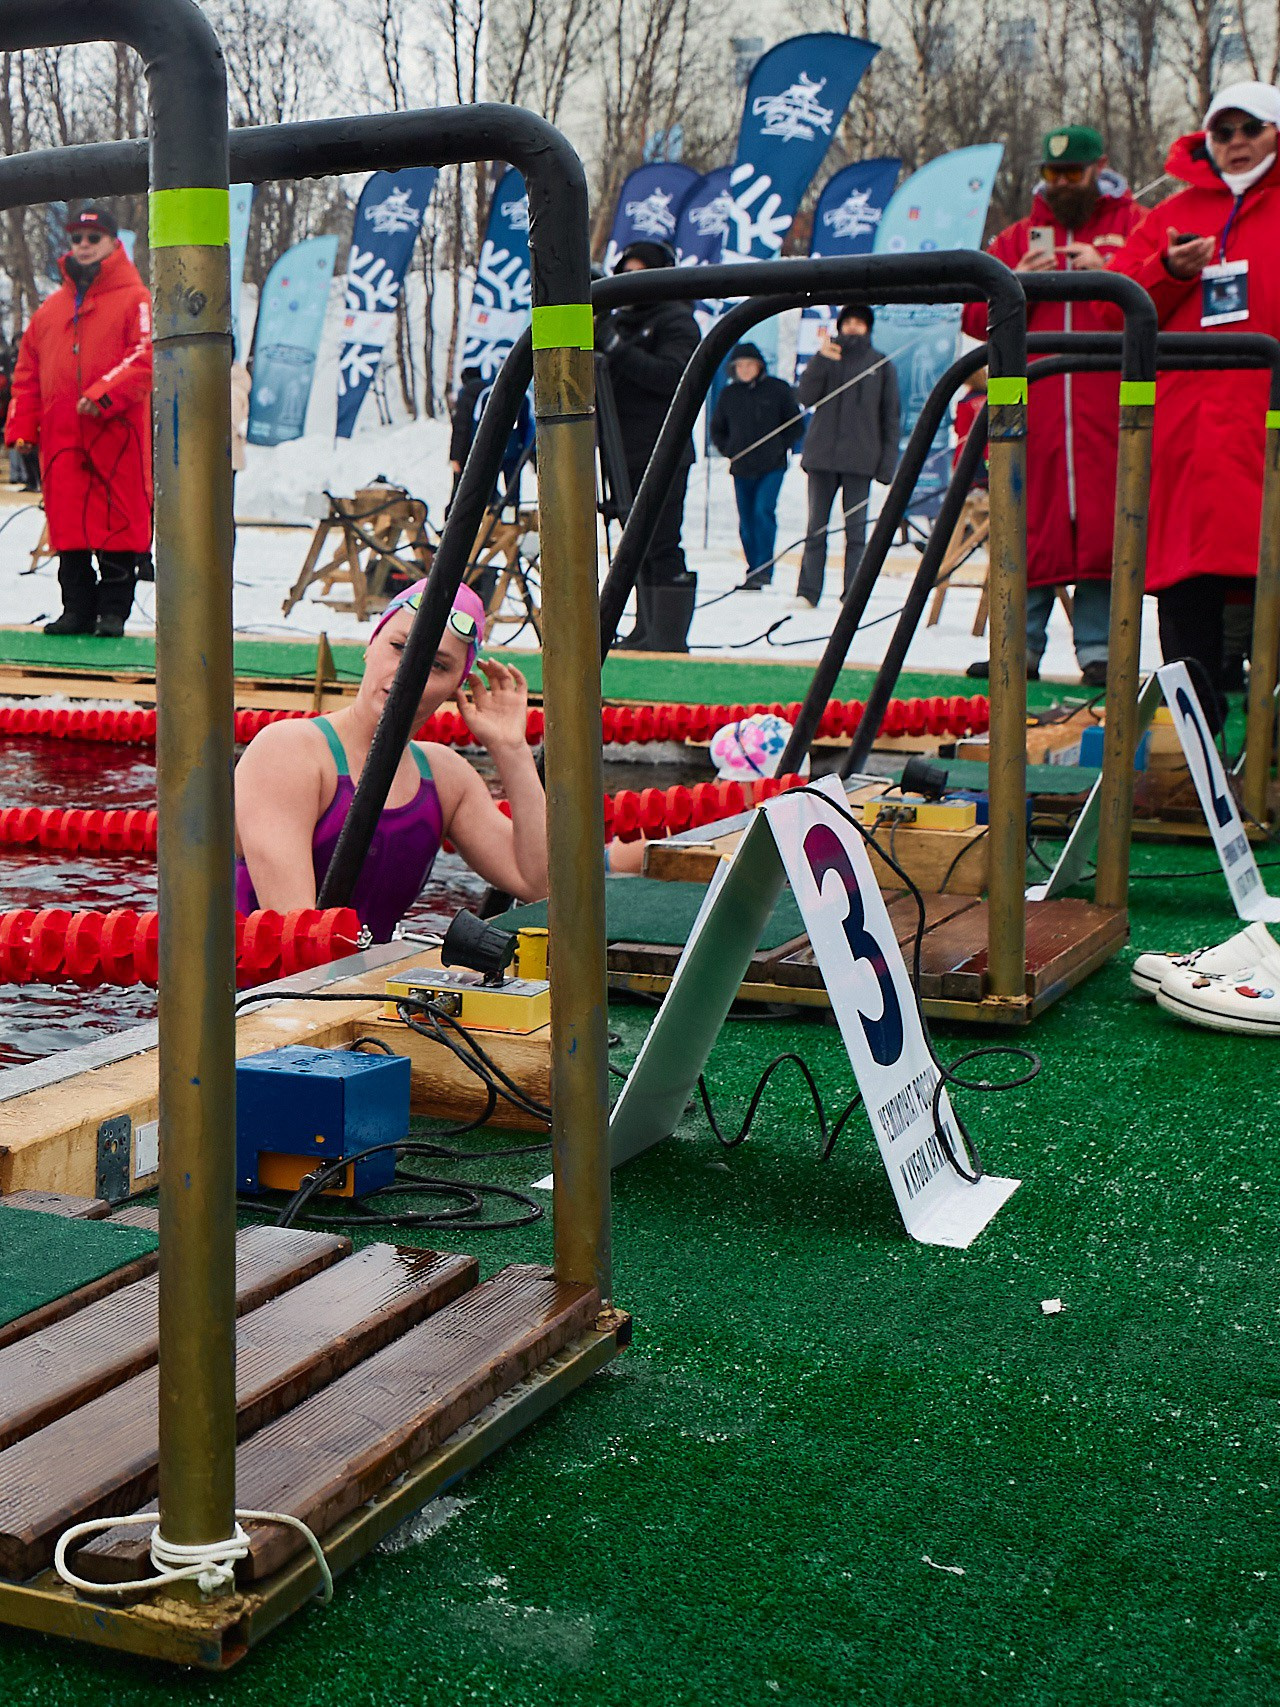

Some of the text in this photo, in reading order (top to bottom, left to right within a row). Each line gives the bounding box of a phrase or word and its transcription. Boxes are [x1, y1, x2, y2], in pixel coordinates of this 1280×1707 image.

[1176, 688, 1233, 828] 2
[803, 823, 905, 1067] 3
[877, 1083, 920, 1143] ЧЕМПИОНАТ
[905, 1143, 933, 1194] КУБОК
